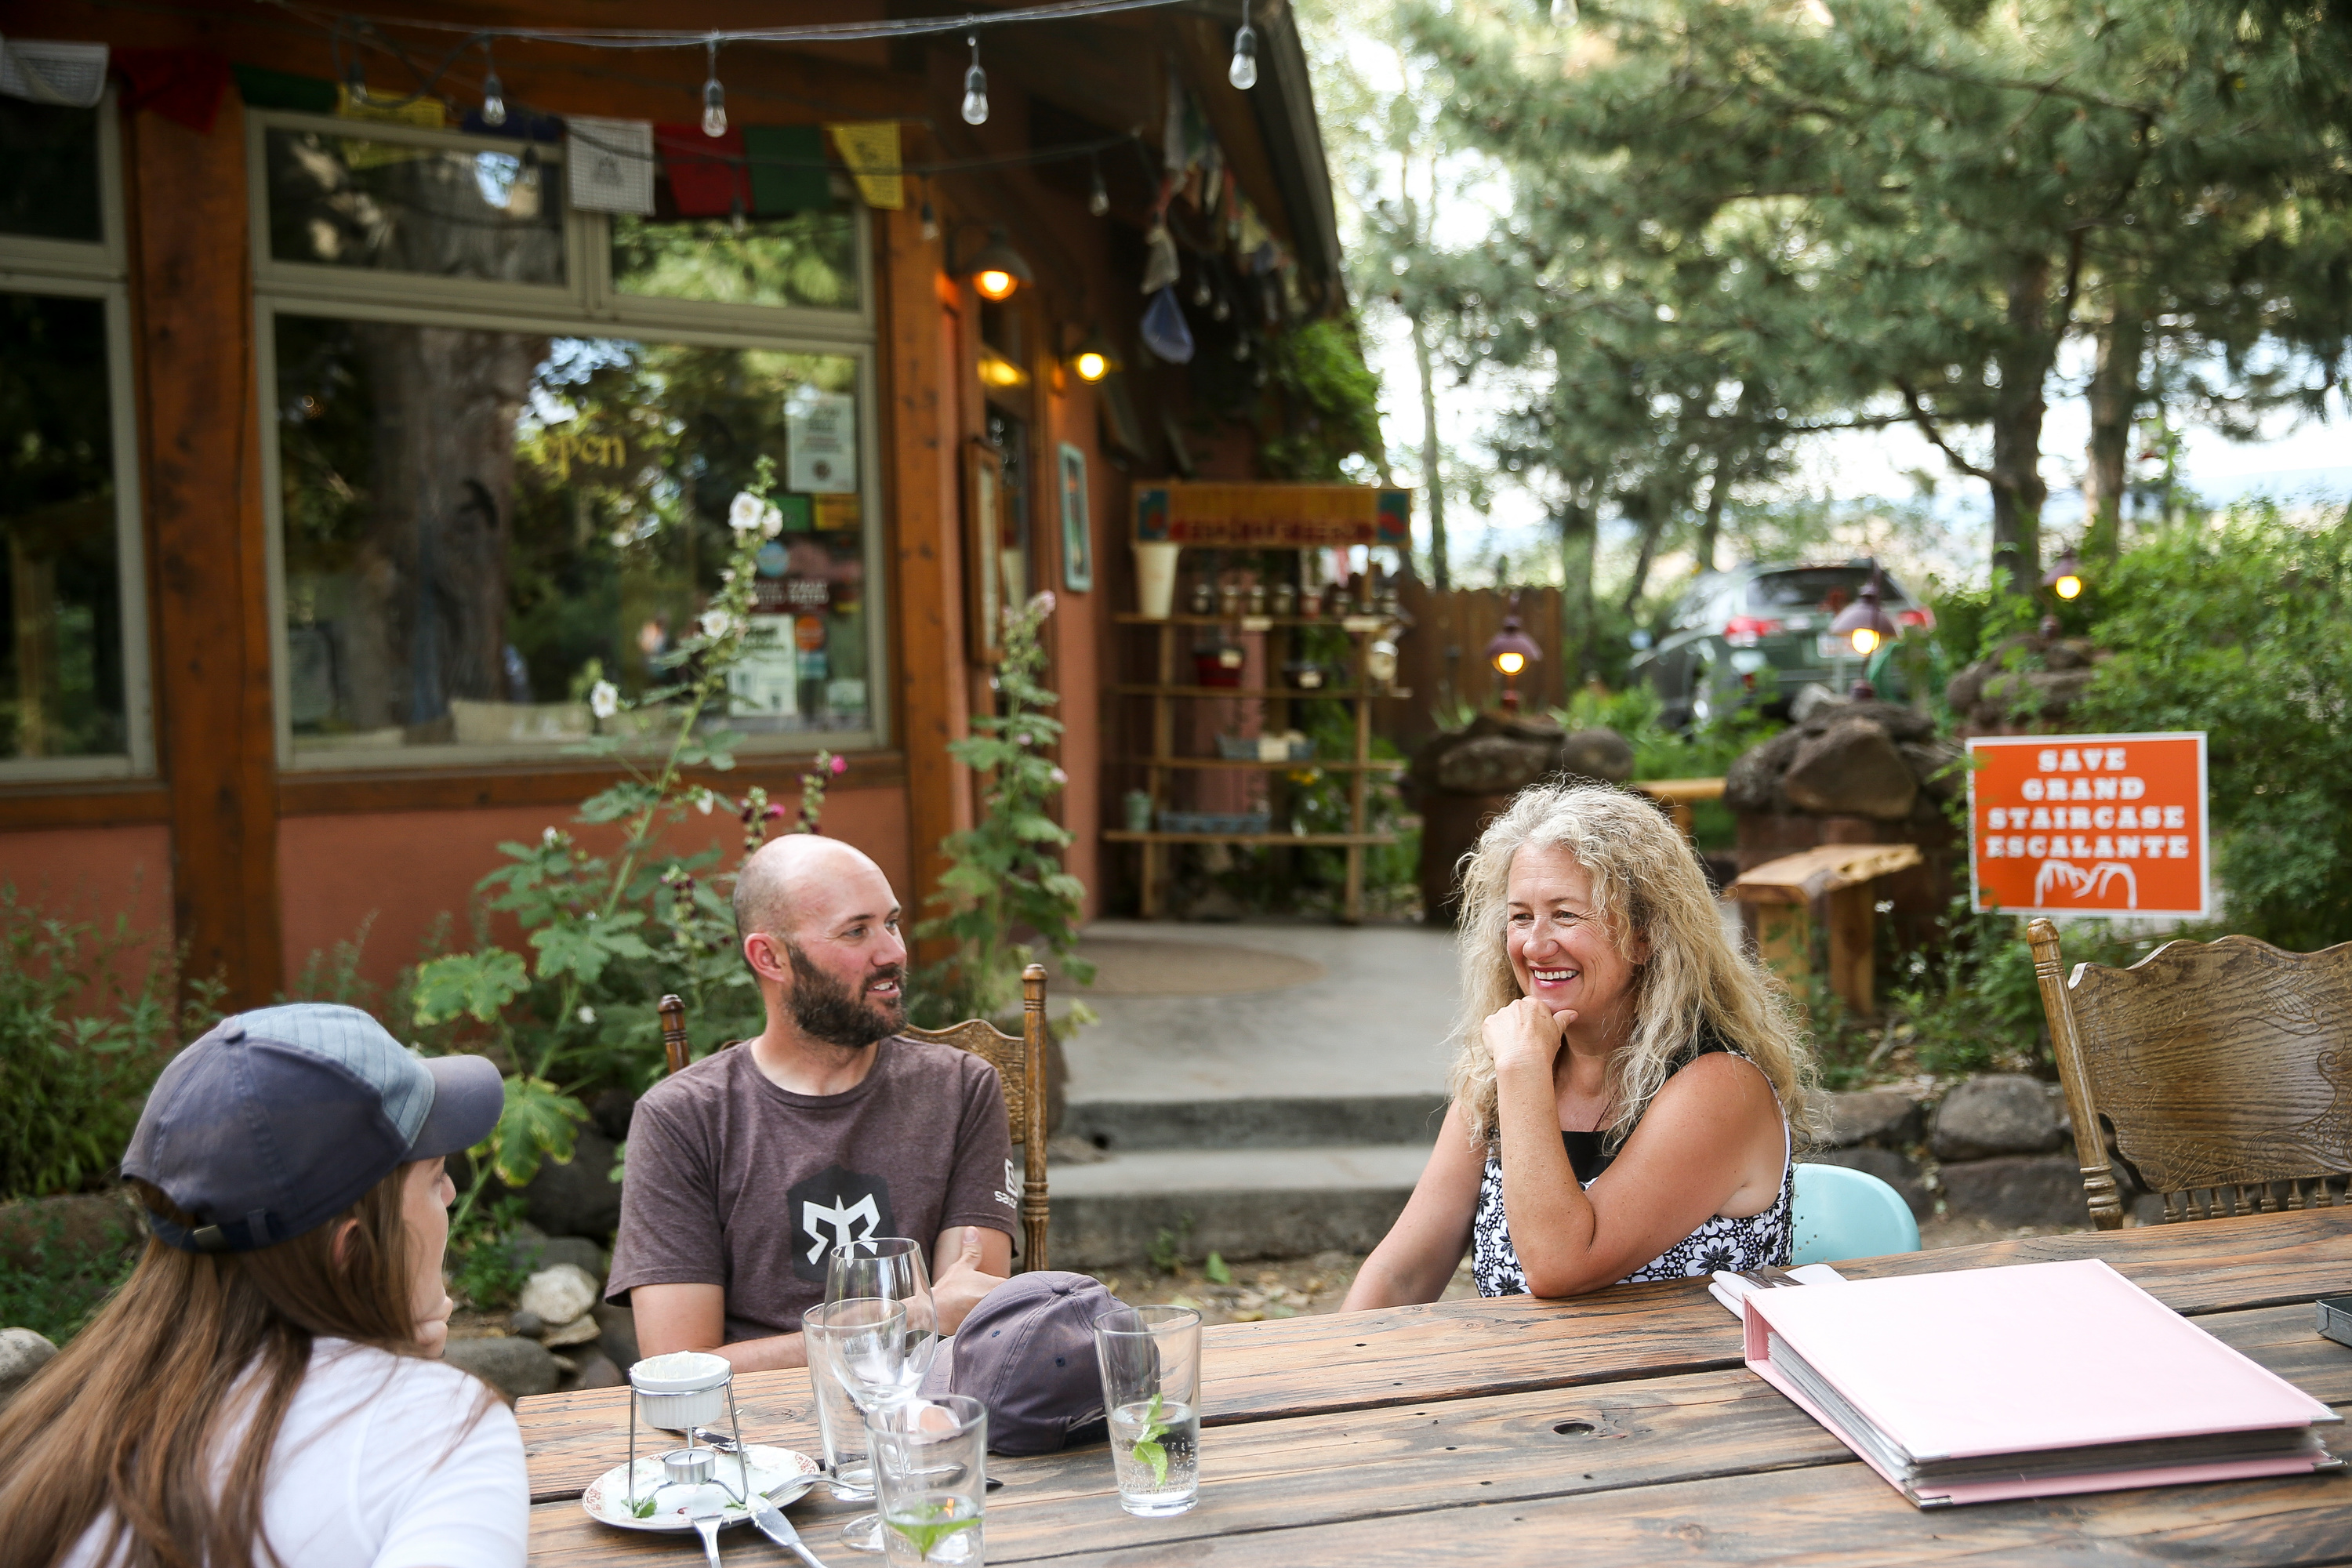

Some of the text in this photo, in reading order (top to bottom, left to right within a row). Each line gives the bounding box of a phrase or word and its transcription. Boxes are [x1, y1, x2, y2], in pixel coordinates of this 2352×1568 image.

[2038, 748, 2126, 771] SAVE
[2022, 777, 2145, 800] GRAND
[1989, 806, 2184, 829] STAIRCASE
[1987, 836, 2188, 858] ESCALANTE
